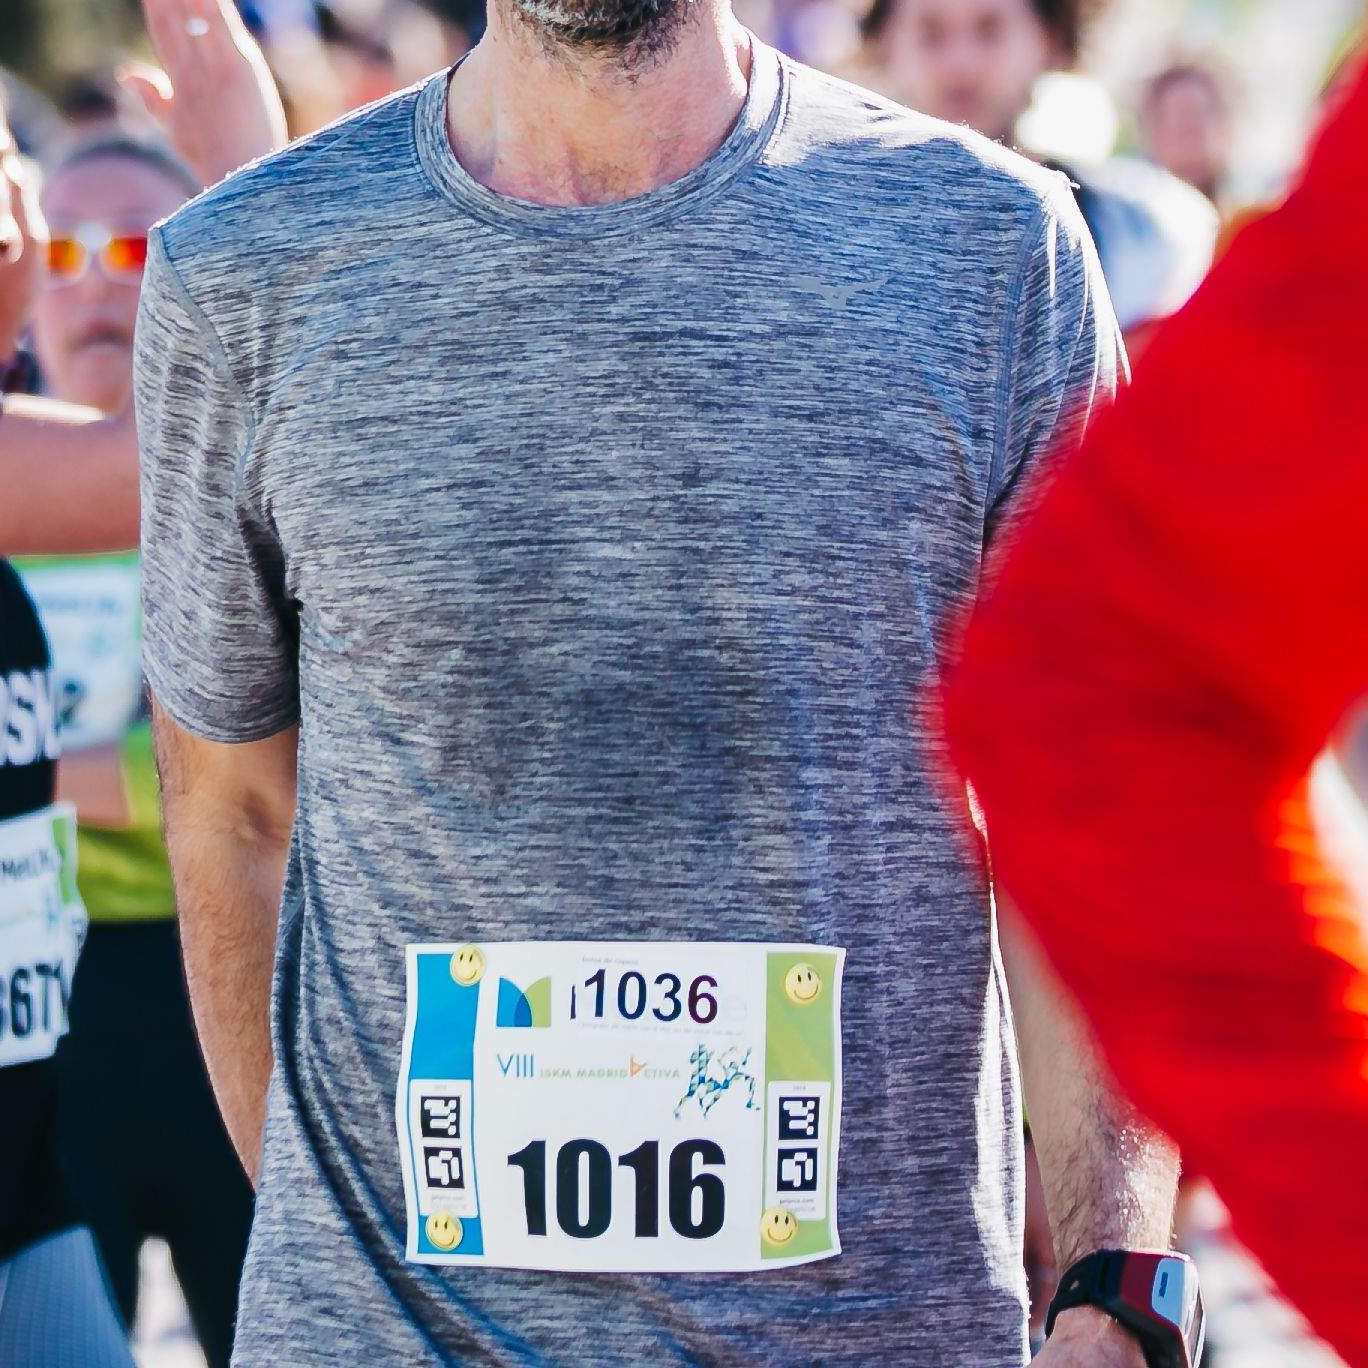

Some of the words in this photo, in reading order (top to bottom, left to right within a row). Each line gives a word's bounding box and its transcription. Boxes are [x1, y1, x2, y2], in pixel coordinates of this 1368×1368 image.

[584, 968, 718, 1024] 1036
[496, 1053, 535, 1078] VIII
[507, 1138, 727, 1240] 1016
